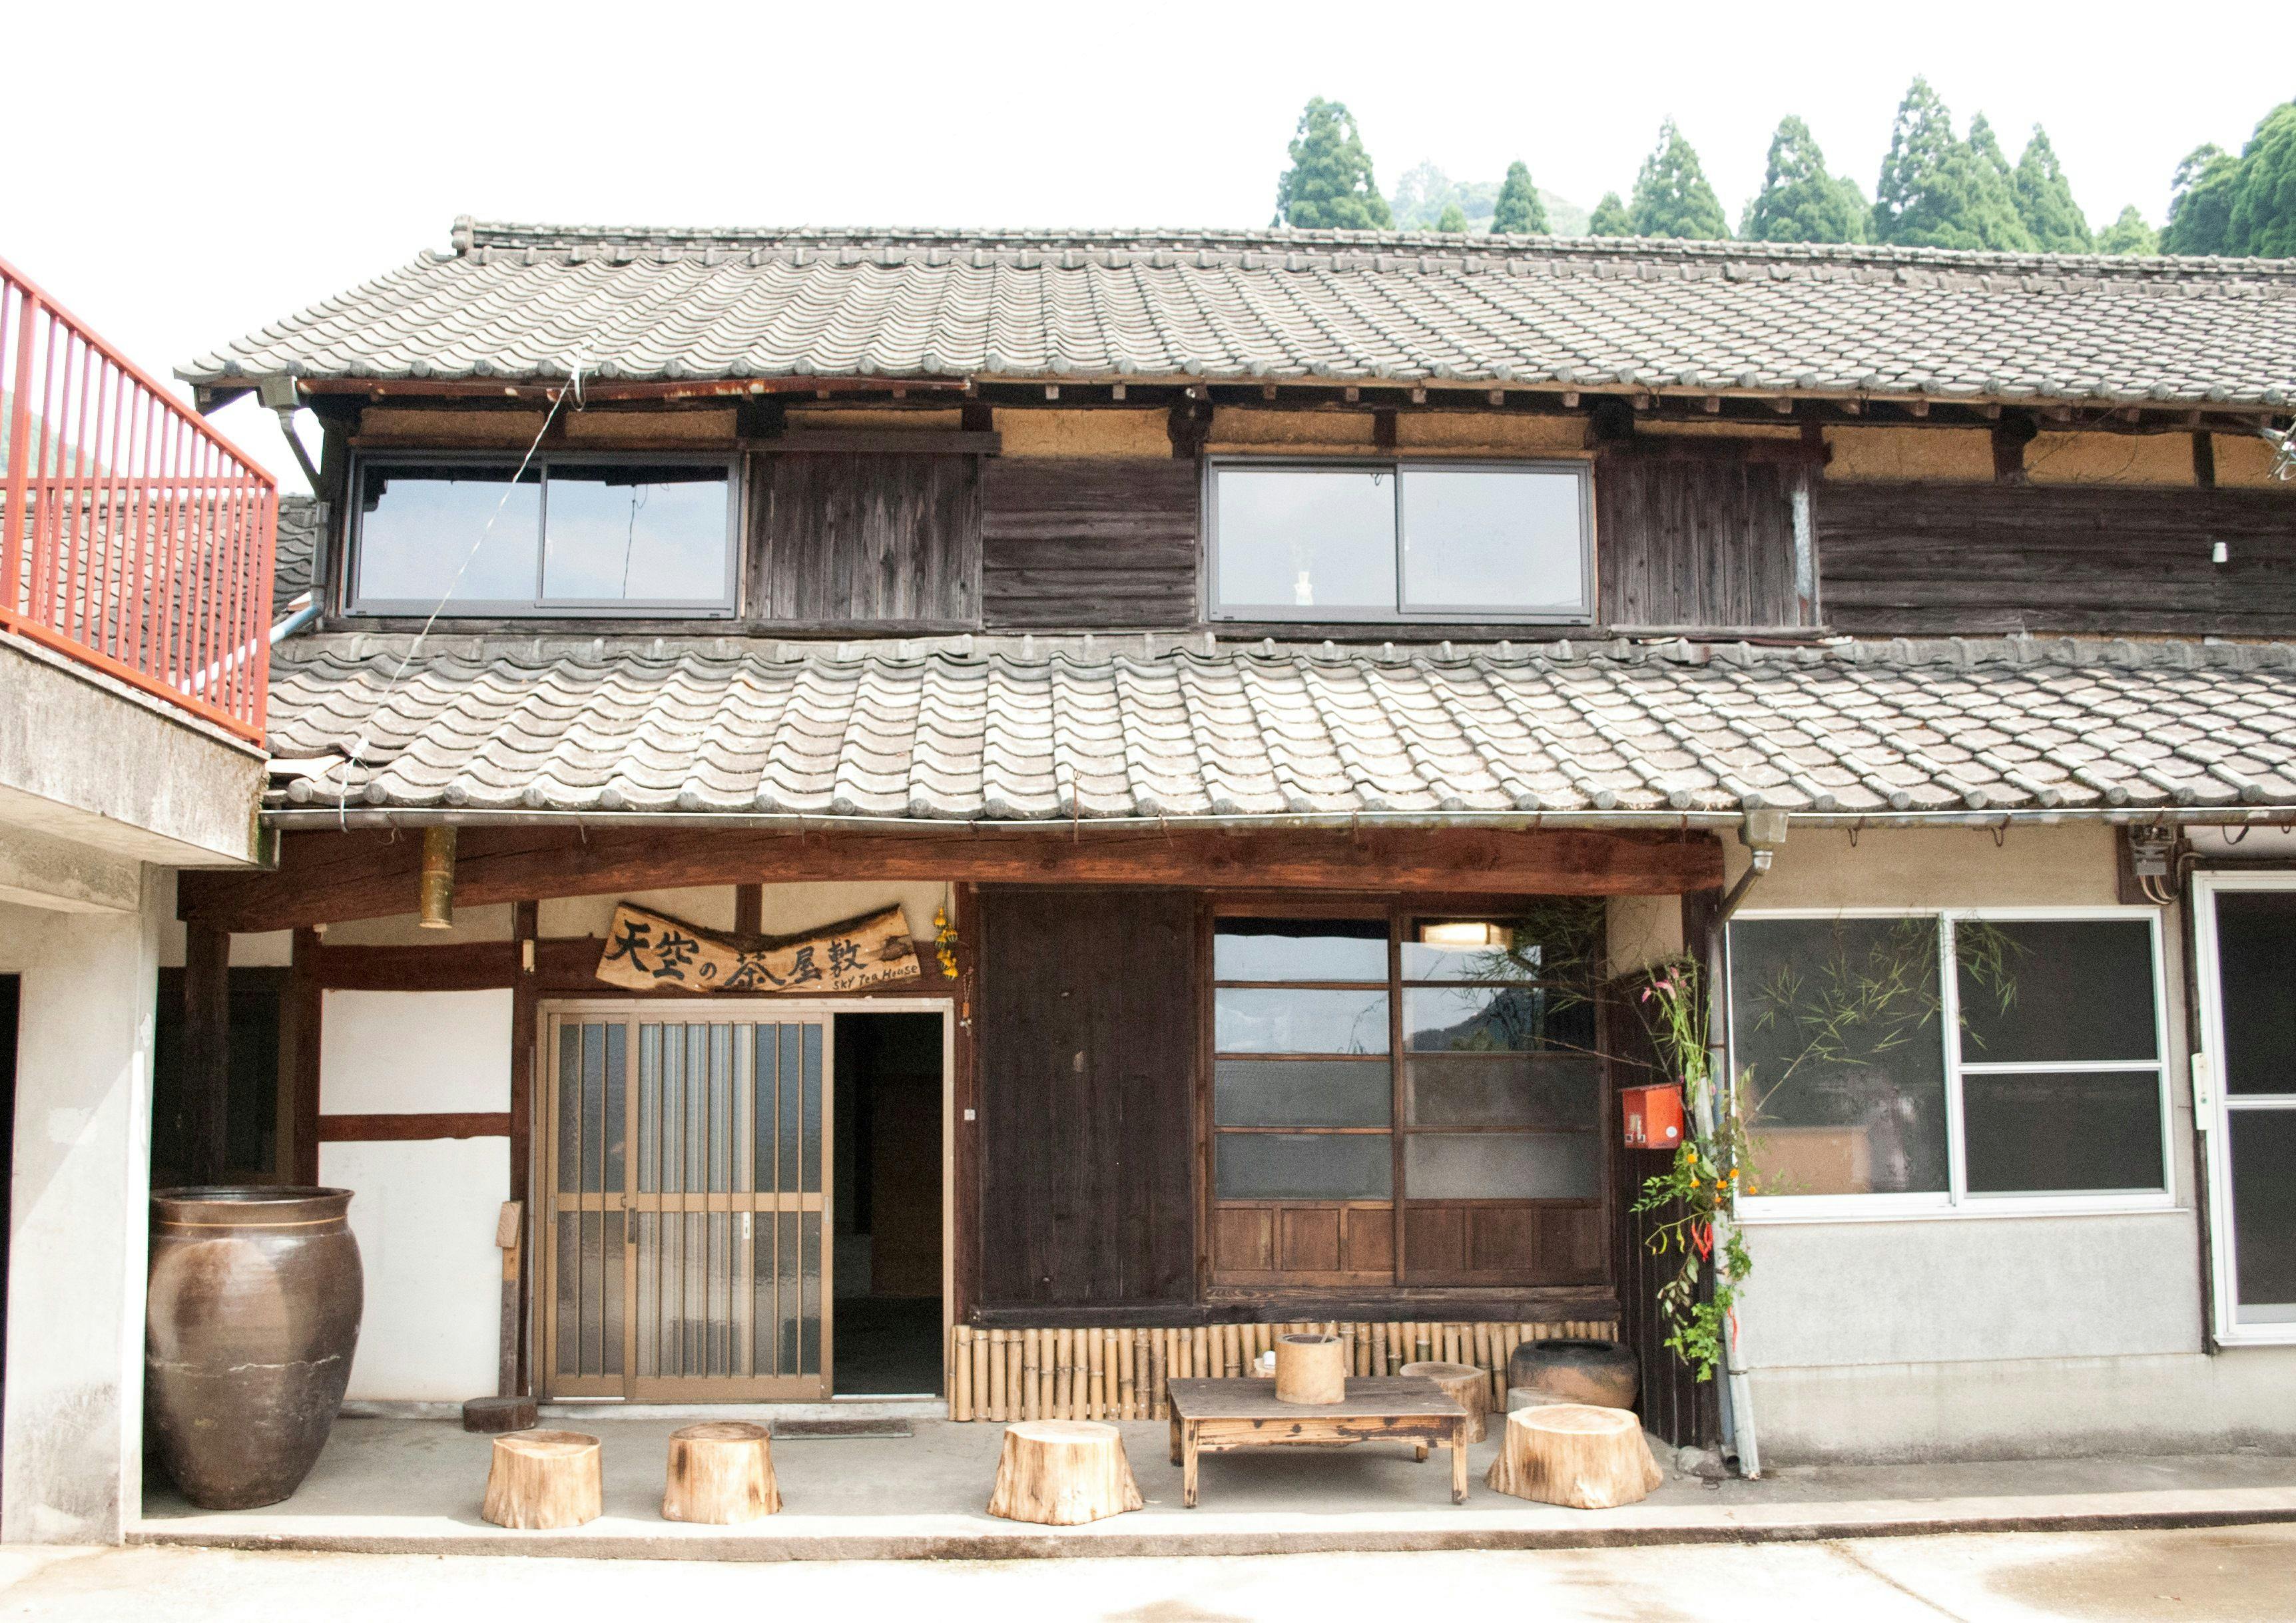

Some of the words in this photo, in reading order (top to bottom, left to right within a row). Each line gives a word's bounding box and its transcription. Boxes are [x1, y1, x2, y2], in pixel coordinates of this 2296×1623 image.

[605, 919, 868, 990] 天空の茶屋敷
[859, 973, 878, 987] Tea
[883, 965, 918, 980] House
